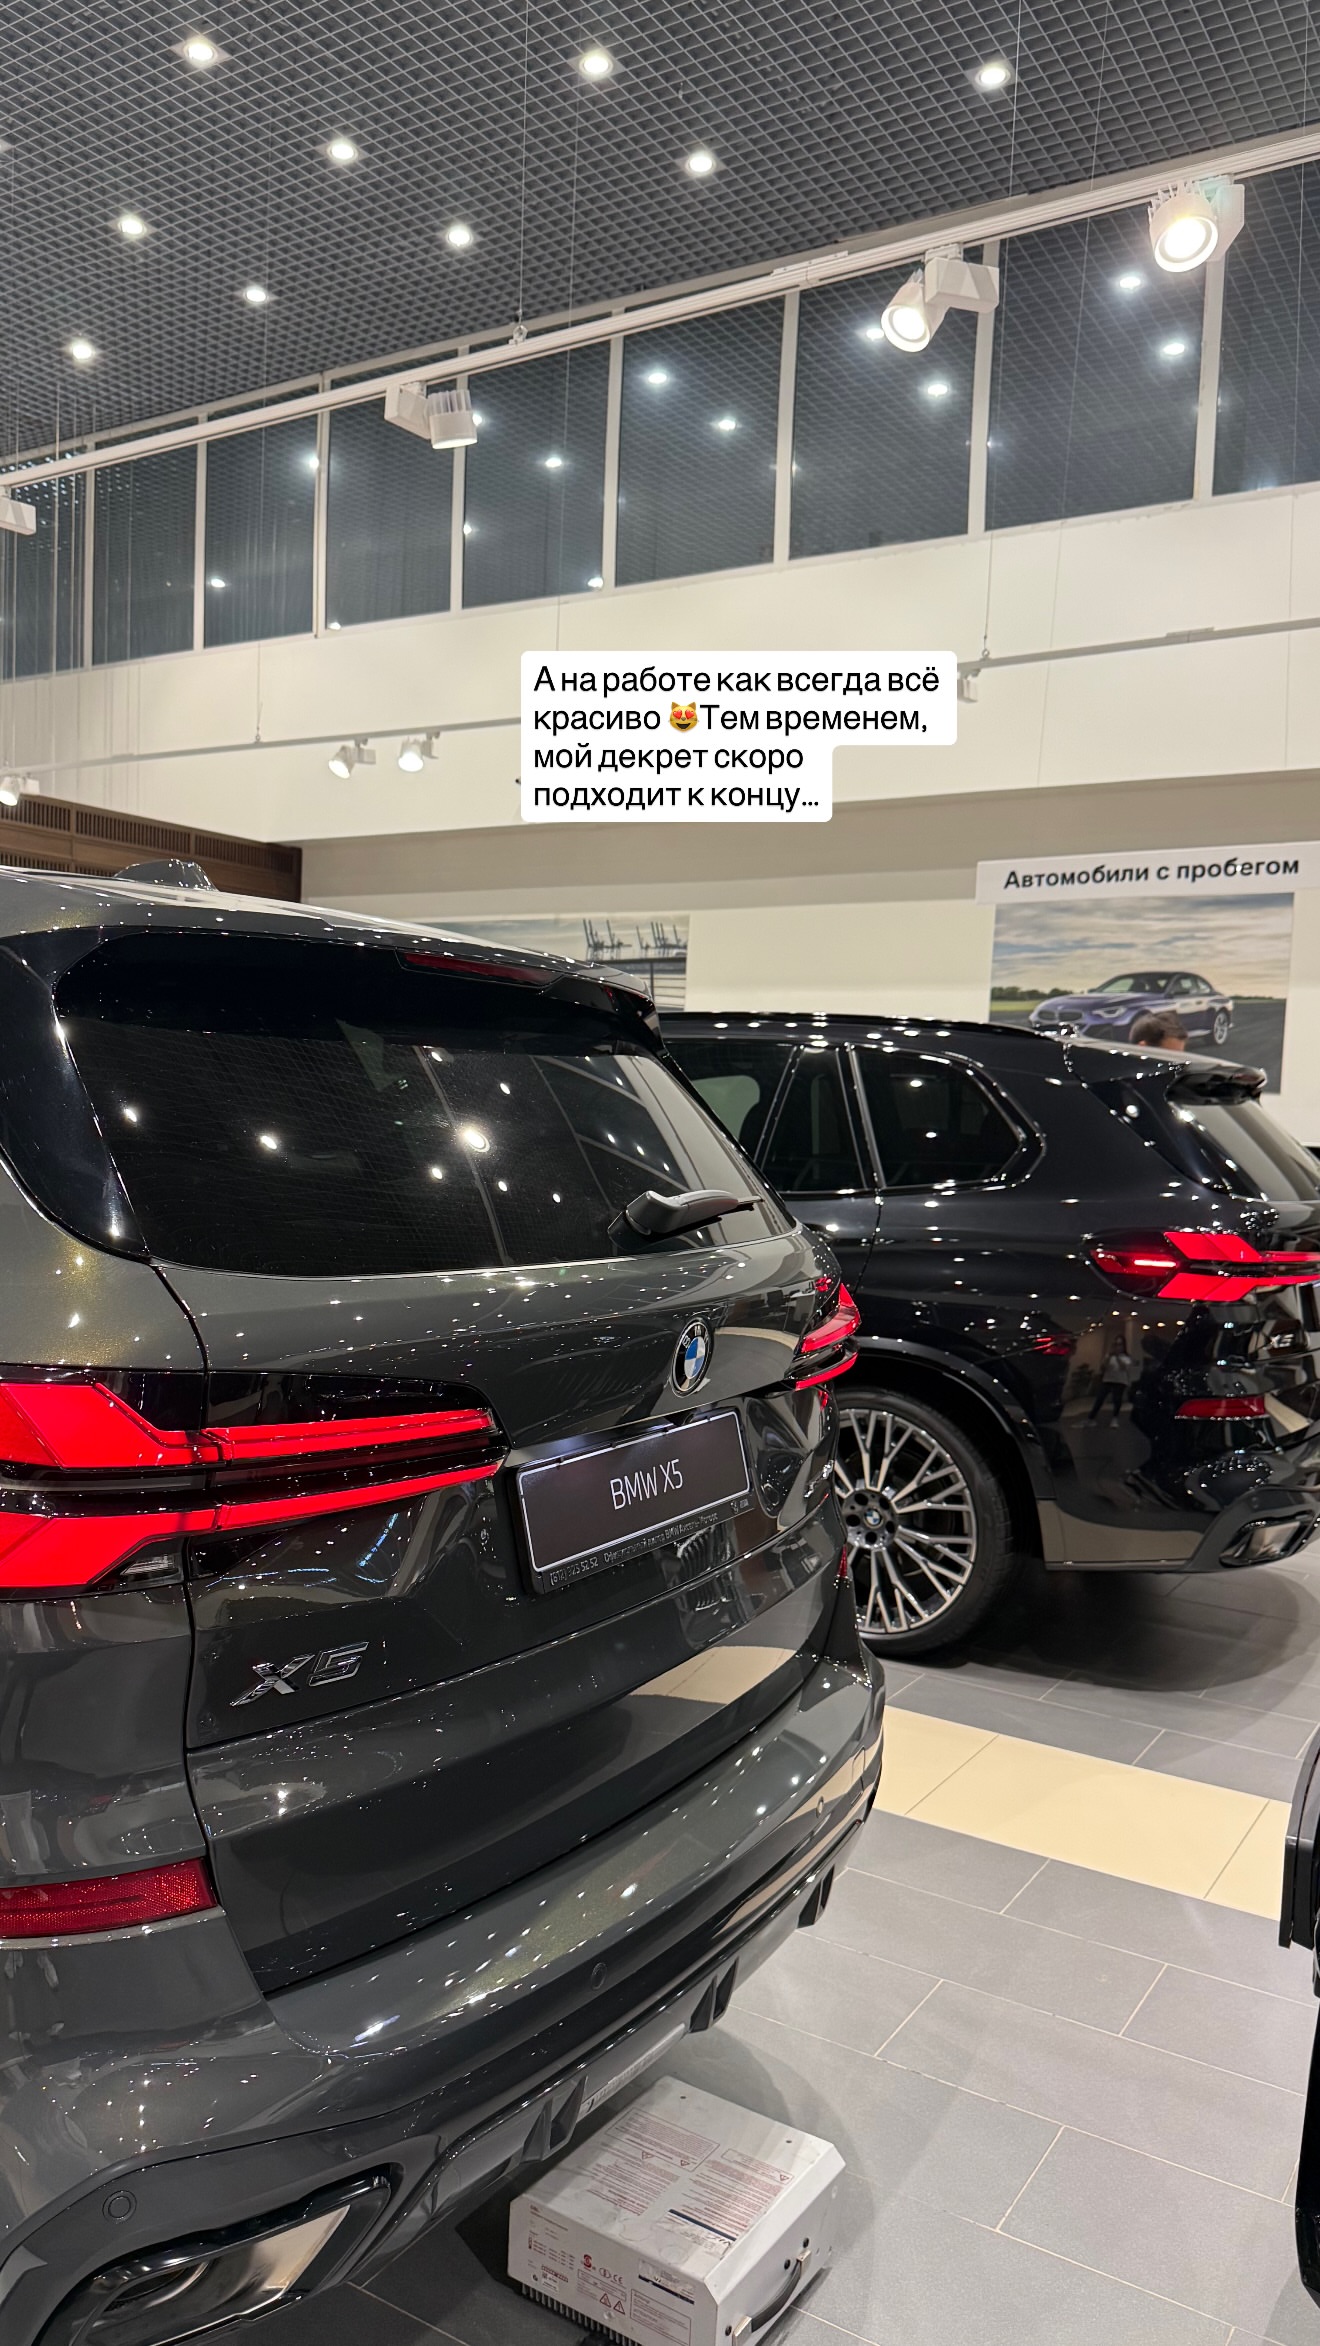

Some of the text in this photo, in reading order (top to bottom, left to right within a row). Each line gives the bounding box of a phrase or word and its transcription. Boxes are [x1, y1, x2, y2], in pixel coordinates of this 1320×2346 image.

[1003, 857, 1299, 890] Автомобили с пробегом
[610, 1458, 683, 1510] BMW X5
[229, 1641, 370, 1707] X5
